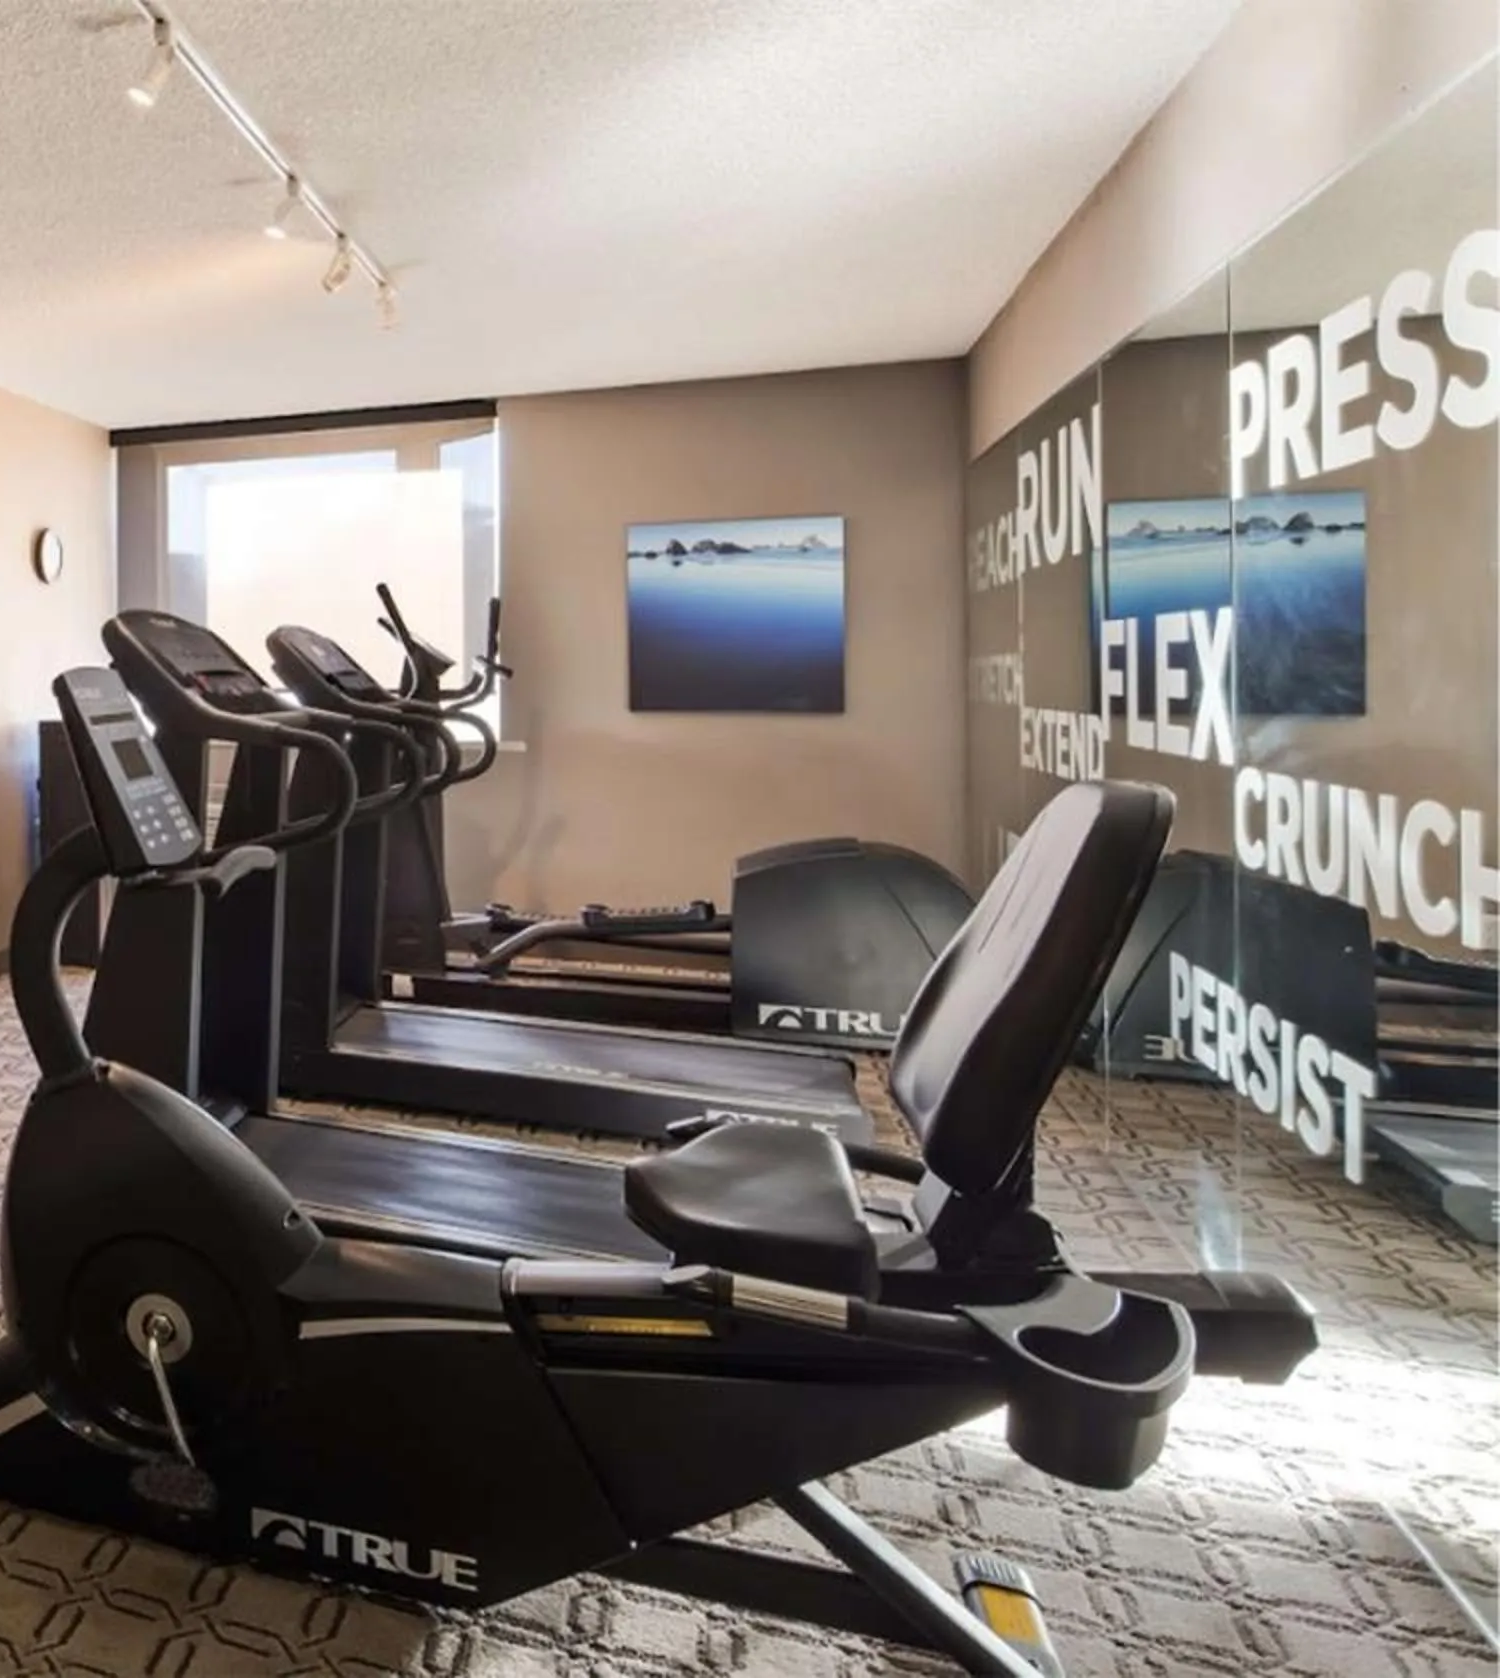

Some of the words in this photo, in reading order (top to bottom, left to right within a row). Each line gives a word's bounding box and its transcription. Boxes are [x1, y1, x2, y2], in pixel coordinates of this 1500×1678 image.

[1229, 229, 1500, 500] PRESS
[1017, 404, 1102, 569] RUN
[970, 653, 1023, 705] RETCH
[1100, 607, 1234, 765] FLEX
[1020, 707, 1106, 782] EXTEND
[804, 1006, 906, 1036] TRU
[1169, 951, 1377, 1185] PERSIST
[308, 1520, 478, 1592] TRUE
